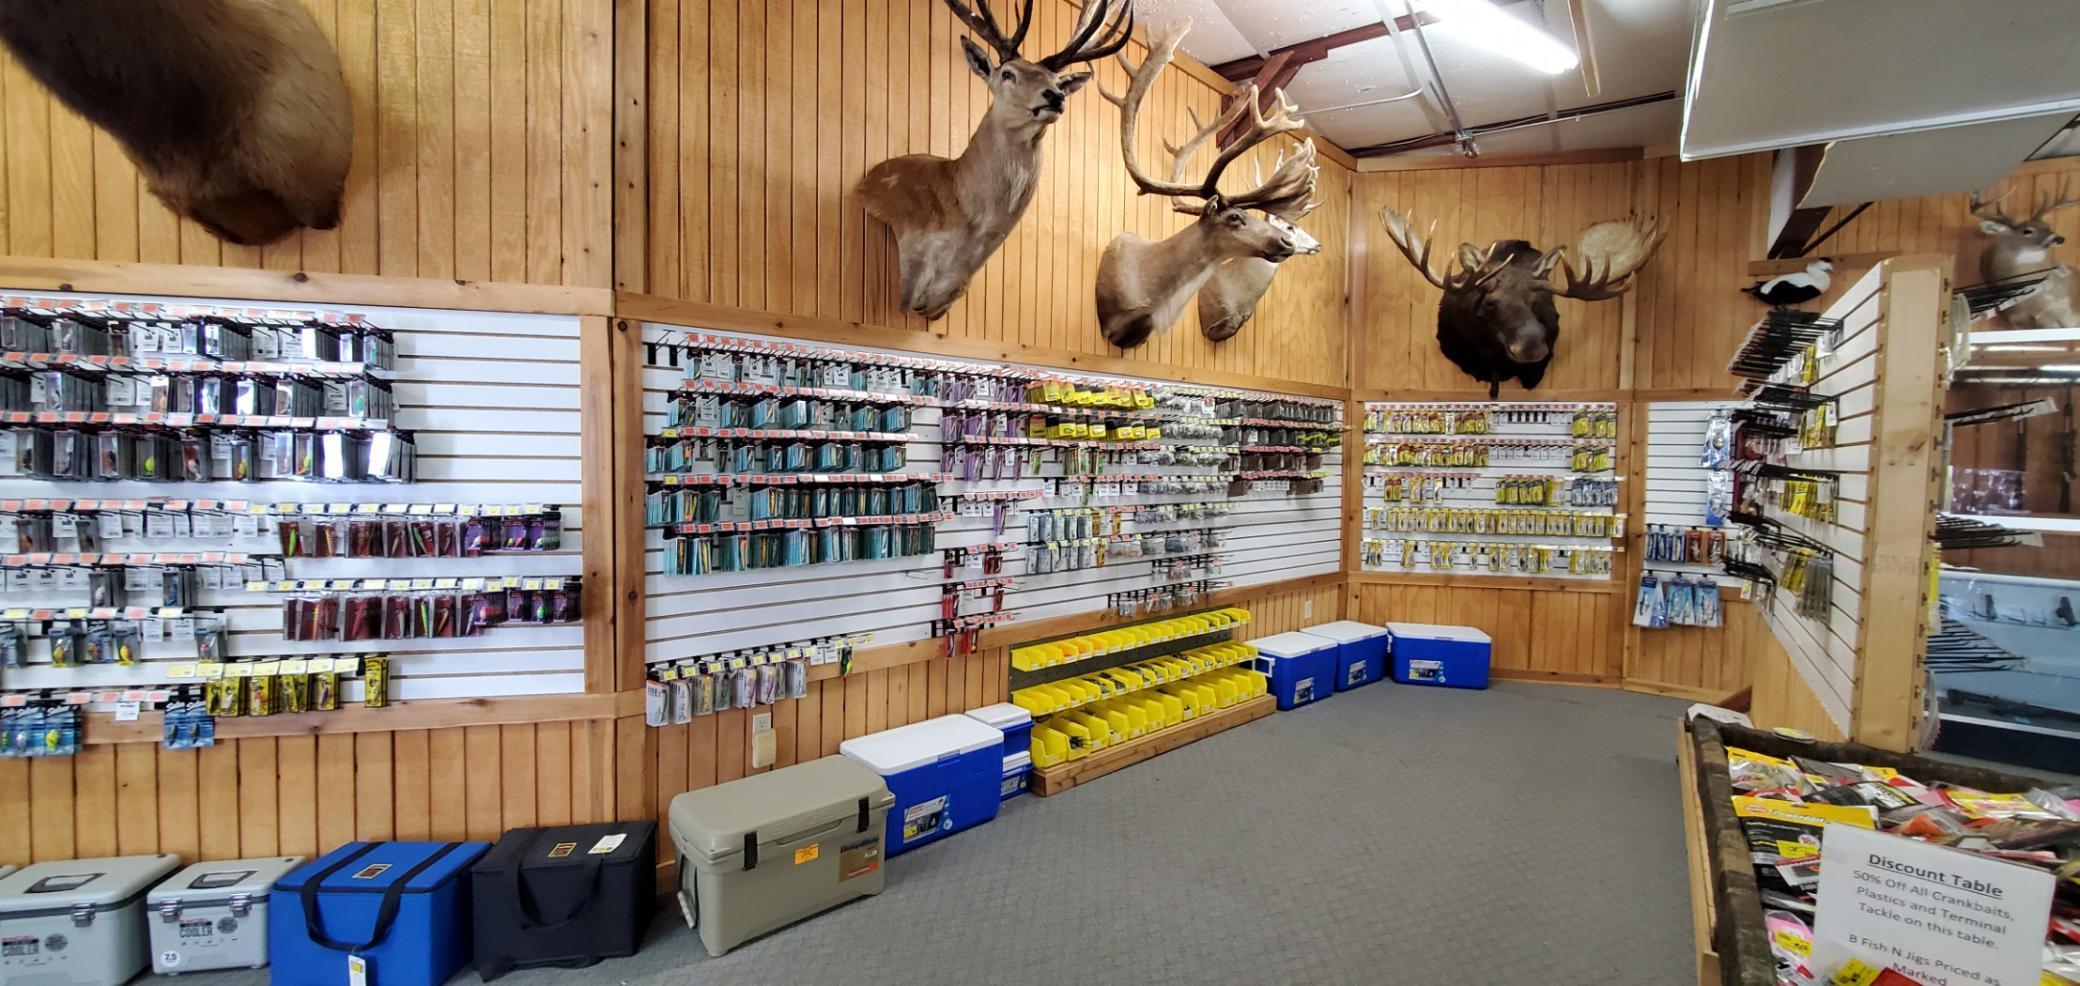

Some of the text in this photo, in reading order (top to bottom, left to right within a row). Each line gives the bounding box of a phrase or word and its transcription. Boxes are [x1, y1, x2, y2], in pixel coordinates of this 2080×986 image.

[1853, 870, 2015, 921] 50% Off All Crankbaits,
[1869, 854, 2003, 897] Discount Table
[180, 926, 212, 937] COOLER
[1857, 886, 2007, 935] Plastics and Terminal
[1859, 902, 1999, 949] Tackle on this table.
[164, 953, 177, 961] 7.5
[1849, 934, 2001, 986] B Fish N Jigs Priced as
[1893, 962, 1947, 986] Marked
